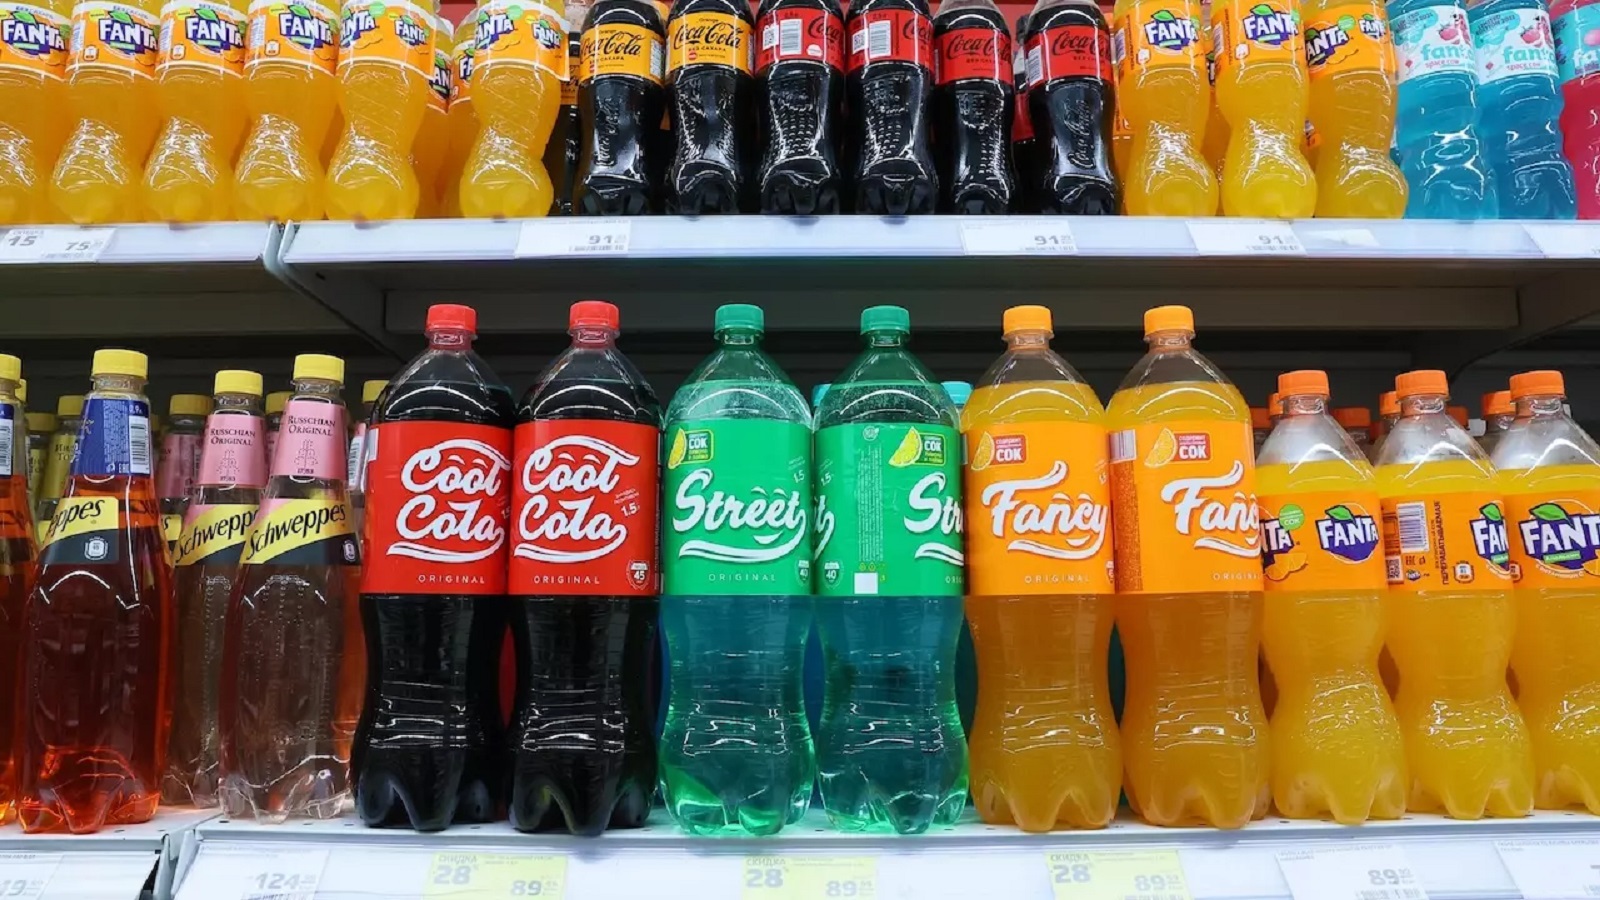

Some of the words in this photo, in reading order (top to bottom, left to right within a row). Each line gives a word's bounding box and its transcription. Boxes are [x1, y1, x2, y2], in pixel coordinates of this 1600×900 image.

[186, 17, 243, 46] FANTA
[280, 14, 333, 44] FANTA
[1145, 19, 1199, 44] FANTA
[1244, 13, 1299, 39] FANTA
[3, 19, 65, 49] FANTA
[100, 19, 157, 49] FANTA
[8, 235, 38, 246] 15
[65, 241, 91, 251] 75
[588, 235, 613, 245] 91
[1034, 235, 1060, 245] 91
[1258, 235, 1284, 245] 91
[287, 414, 336, 428] RUSSCHIAN
[210, 428, 256, 438] RUSSCHIAN
[288, 424, 333, 437] ORIGINAL
[210, 436, 253, 446] ORIGINAL
[688, 438, 708, 449] СОК
[924, 440, 942, 452] СОК
[995, 448, 1023, 463] СОК
[1178, 445, 1207, 460] СОК
[401, 438, 511, 497] Cool
[523, 435, 640, 494] Cool
[673, 468, 806, 548] Street
[982, 460, 1108, 555] Fancy
[390, 494, 505, 552] Cola
[517, 494, 627, 552] Cola
[1283, 517, 1300, 526] СОК
[246, 504, 346, 560] Schweppes
[1316, 516, 1379, 549] FANTA
[1520, 513, 1600, 555] FANT
[418, 574, 485, 584] ORIGINAL
[533, 575, 600, 584] ORIGINAL
[633, 570, 645, 580] 45
[708, 573, 776, 582] ORIGINAL
[825, 569, 837, 580] 40
[1024, 573, 1090, 584] ORIGINAL
[438, 854, 478, 865] СКИДКА
[746, 858, 786, 866] СКИДКА
[1050, 853, 1090, 862] СКИДКА
[256, 872, 301, 890] 124
[434, 864, 472, 885] 28
[746, 868, 784, 888] 28
[1052, 864, 1091, 883] 28
[1368, 868, 1399, 885] 89
[511, 880, 542, 896] 89
[826, 880, 857, 897] 89
[1135, 875, 1166, 891] 89
